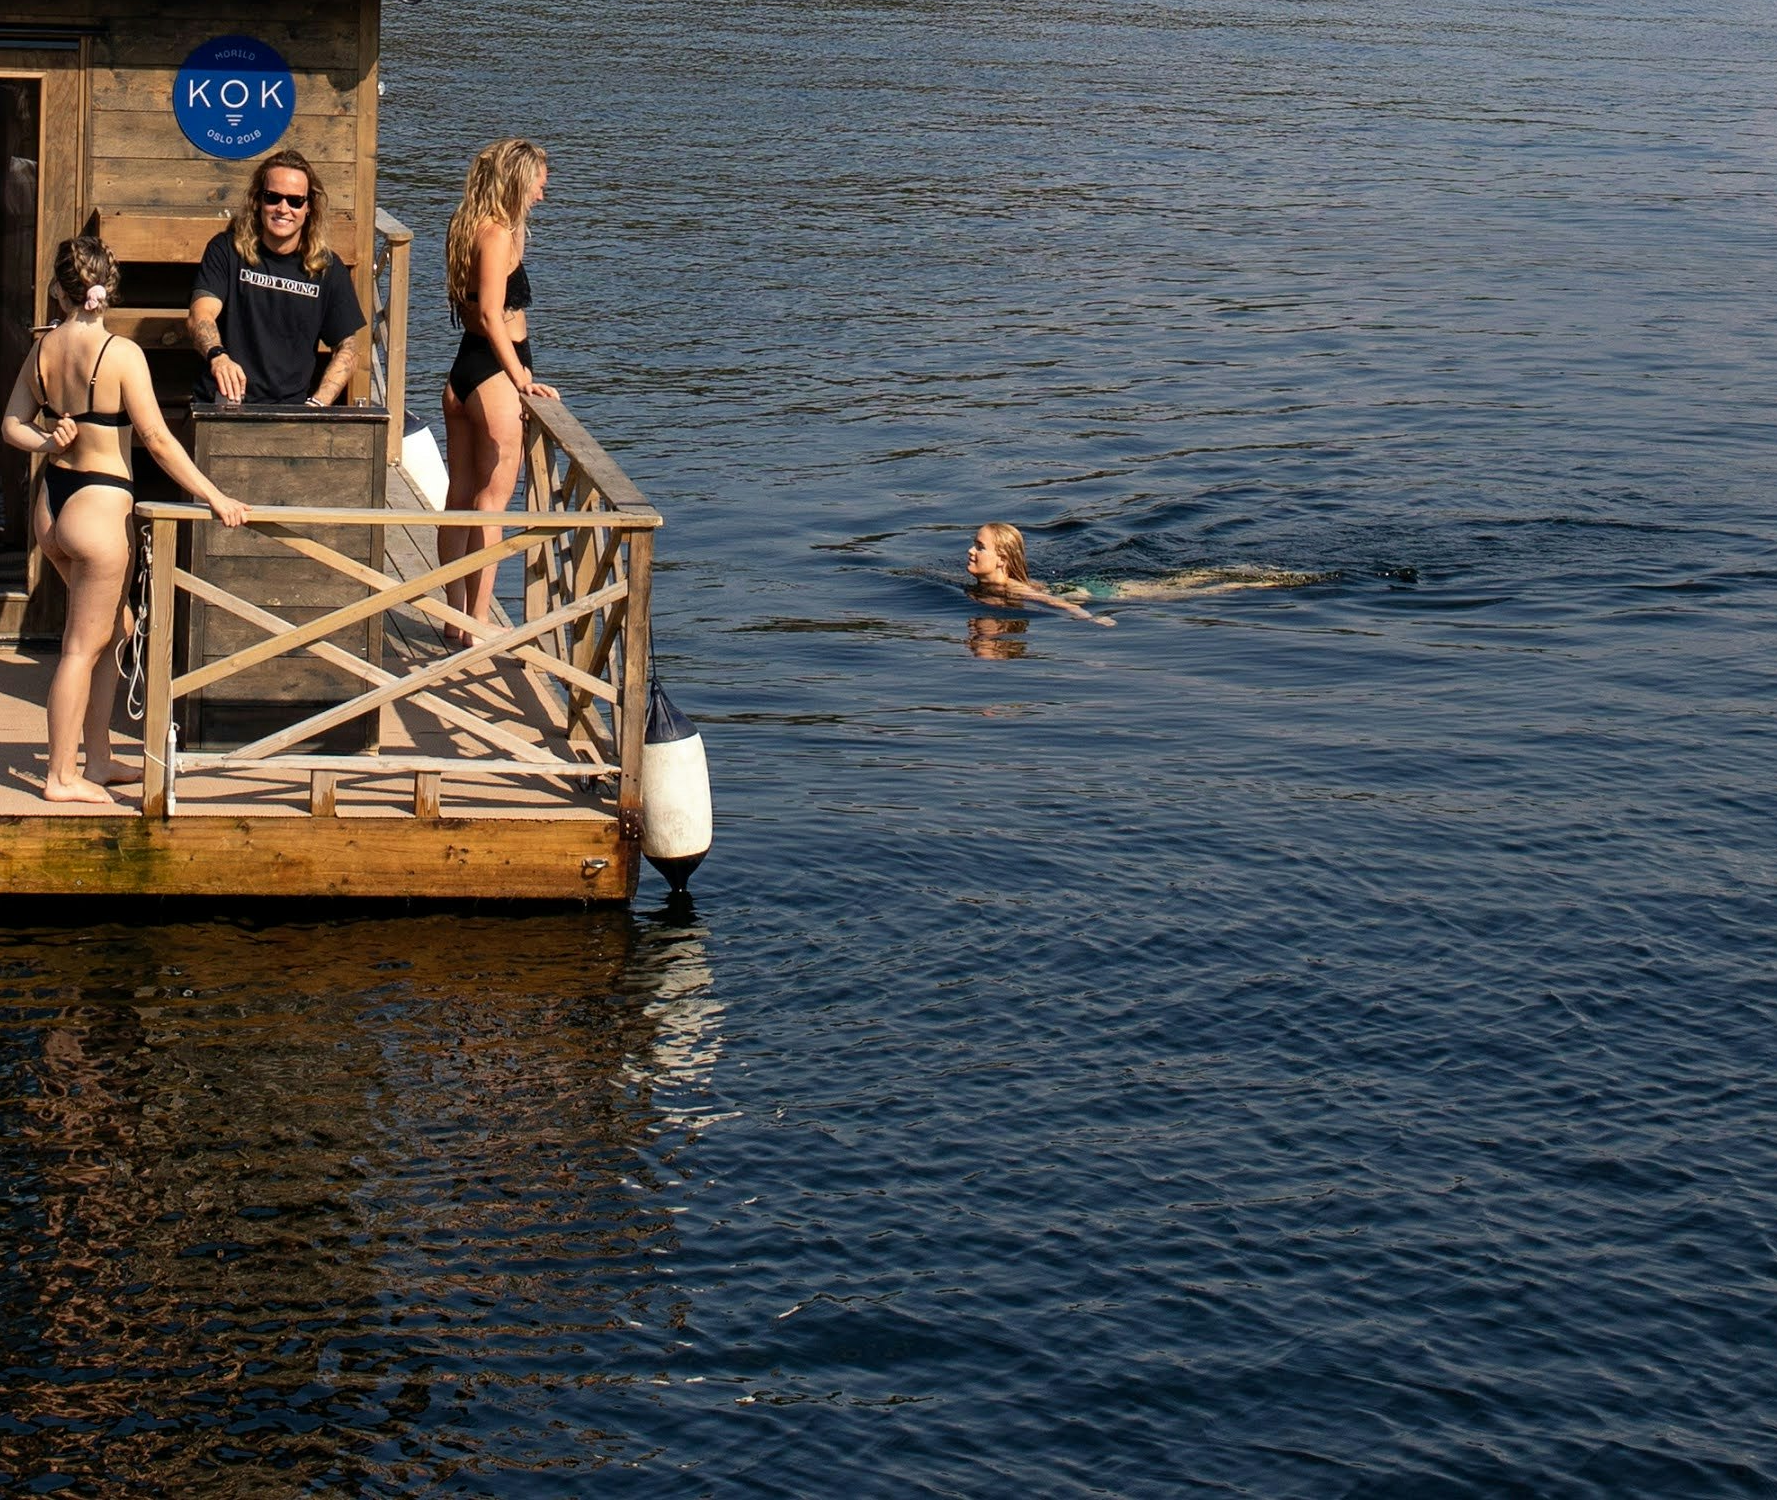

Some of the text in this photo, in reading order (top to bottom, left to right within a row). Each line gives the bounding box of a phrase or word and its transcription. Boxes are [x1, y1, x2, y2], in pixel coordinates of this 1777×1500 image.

[214, 49, 256, 61] MORILD
[188, 79, 284, 109] KOK
[207, 129, 262, 145] OSLO 2018
[281, 279, 316, 295] YOUNG
